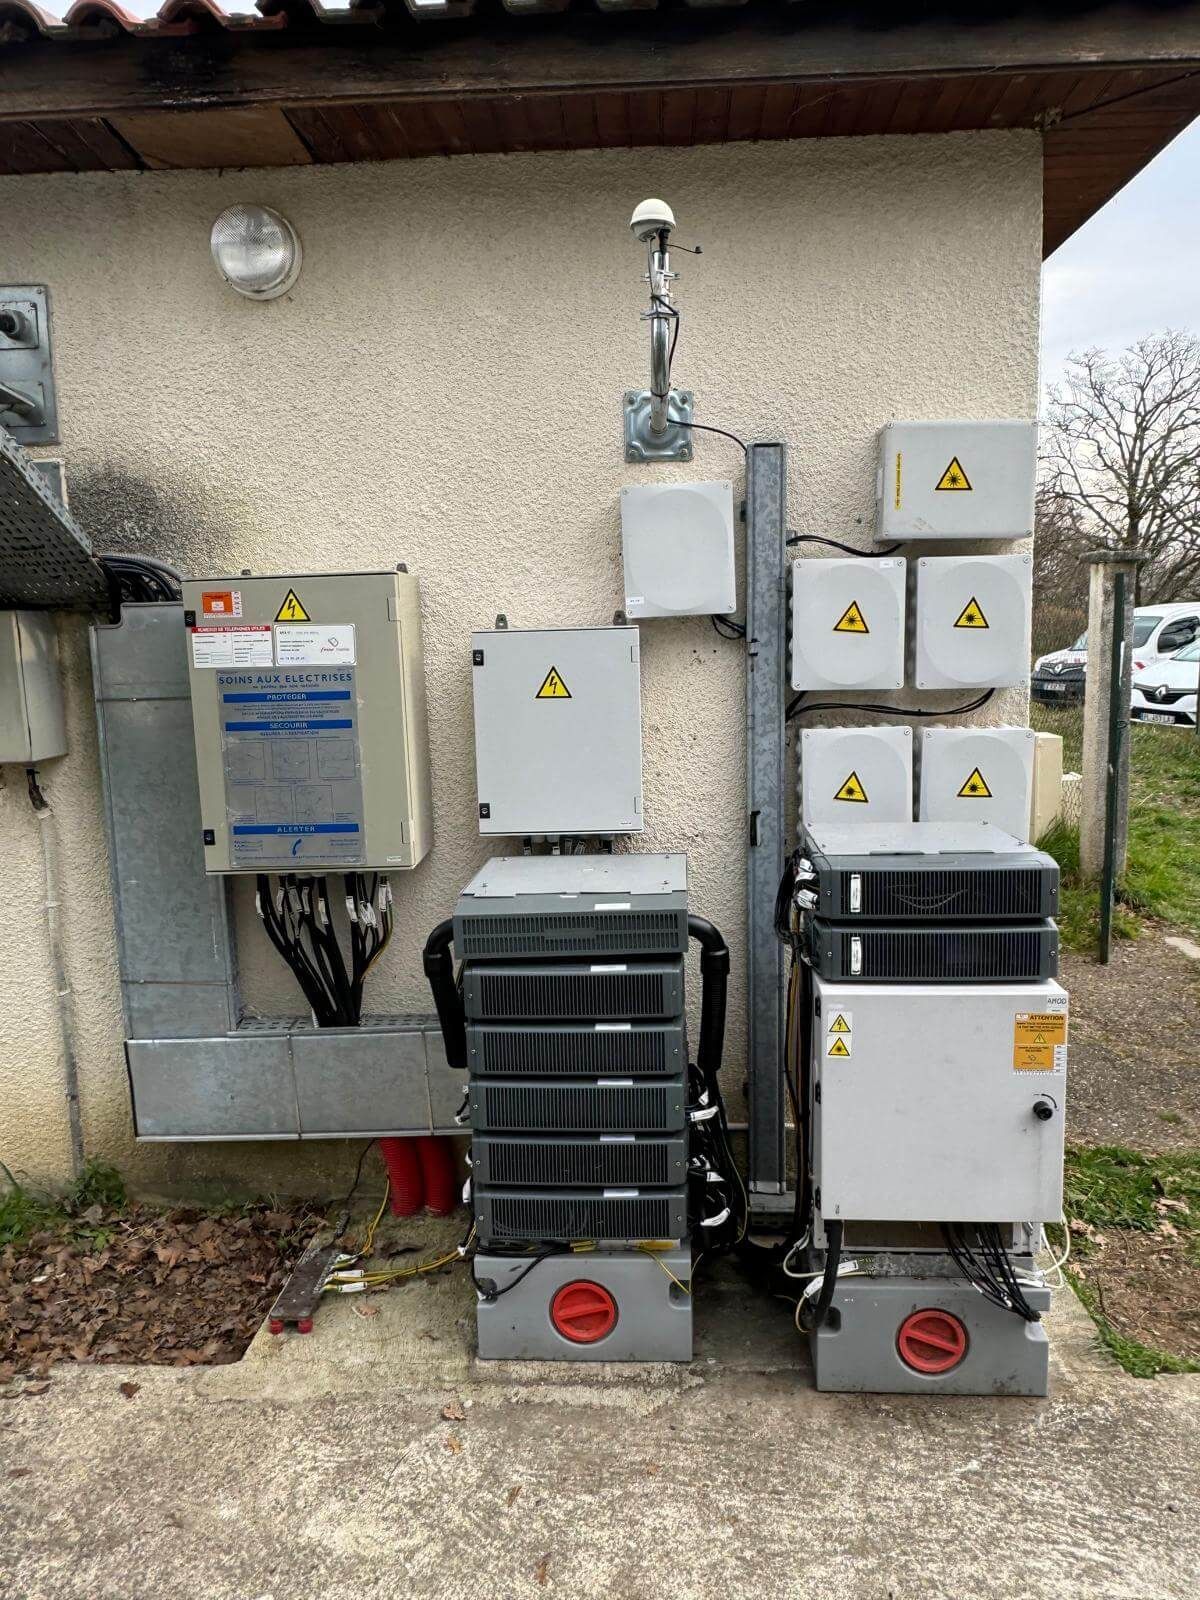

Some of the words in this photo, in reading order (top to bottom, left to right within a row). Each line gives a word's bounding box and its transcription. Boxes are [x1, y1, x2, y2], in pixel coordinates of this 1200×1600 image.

[218, 675, 253, 685] SOINS
[256, 674, 281, 684] AUX
[285, 673, 353, 683] ELECTRISES
[266, 693, 307, 701] PROTEGER
[277, 825, 316, 833] ALERTER
